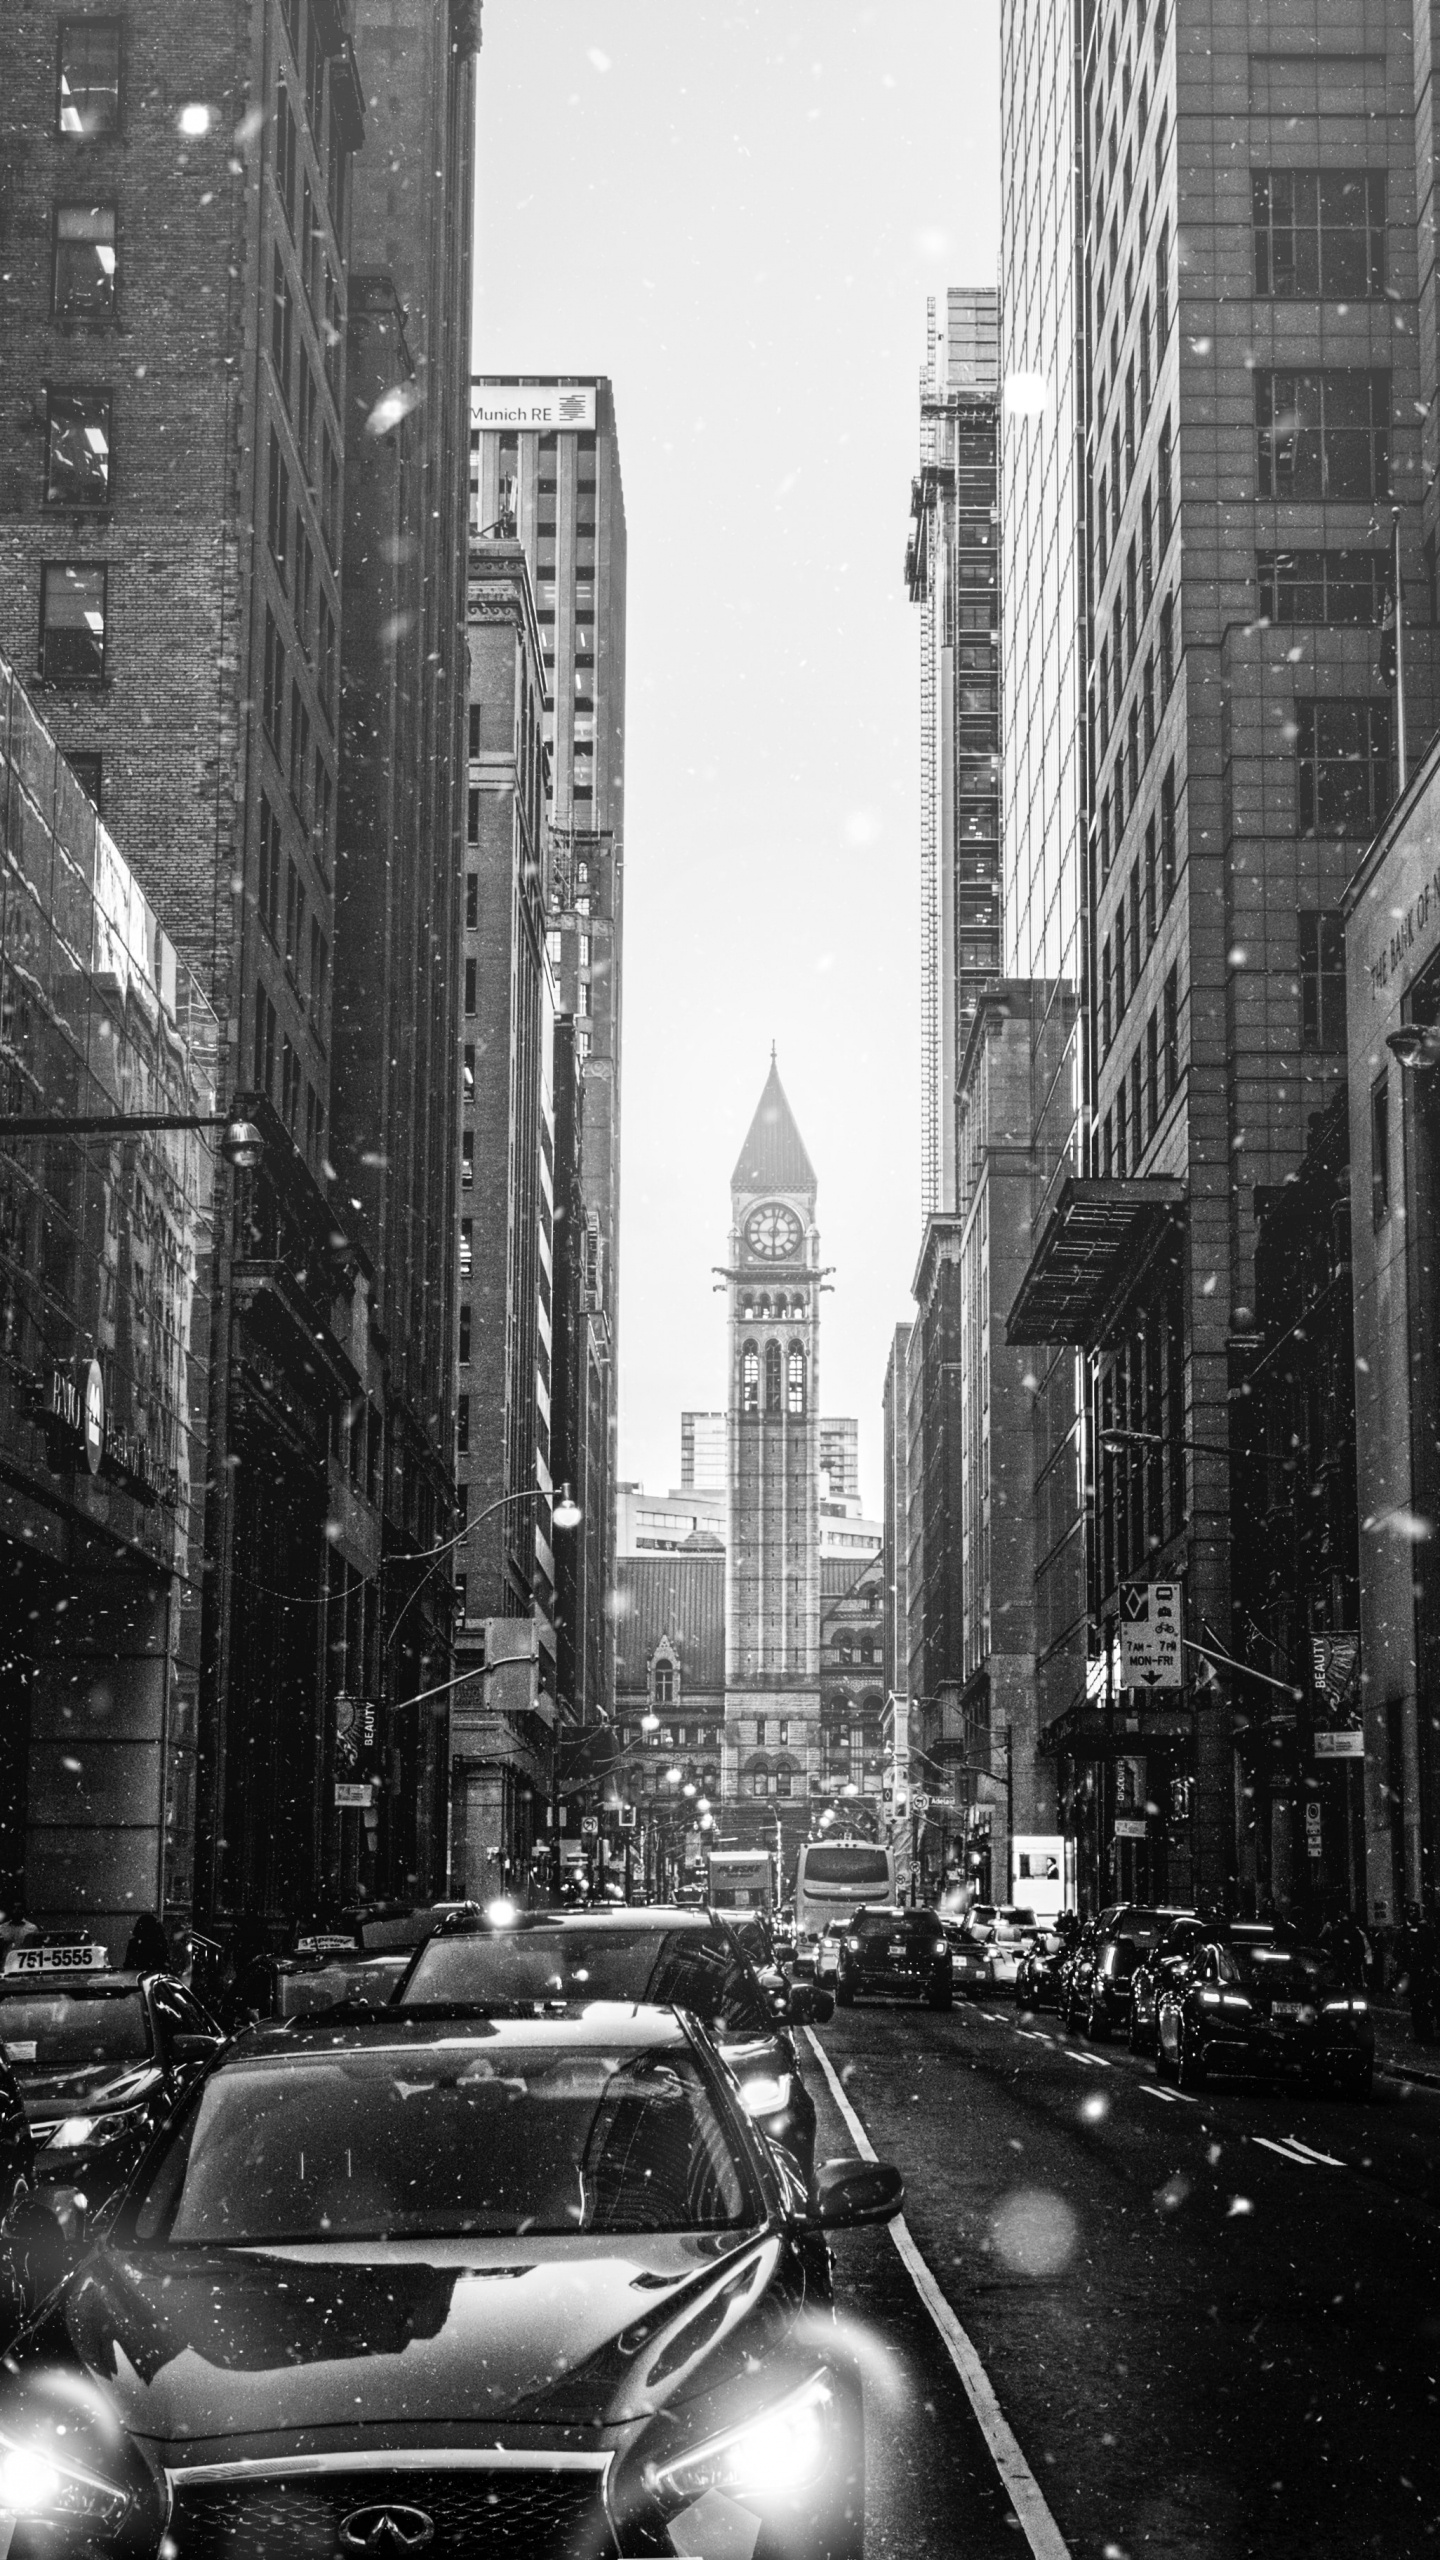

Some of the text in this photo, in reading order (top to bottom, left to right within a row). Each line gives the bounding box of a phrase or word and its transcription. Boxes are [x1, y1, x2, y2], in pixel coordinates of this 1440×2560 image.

[471, 407, 552, 421] Munich RE
[1371, 950, 1387, 1001] THE
[1391, 908, 1414, 972] BANK
[1417, 884, 1429, 931] OF
[1129, 1656, 1174, 1667] MON-FRI
[1312, 1638, 1326, 1688] BEAUTY
[364, 1702, 376, 1746] BEAUTY
[1116, 1760, 1126, 1801] DISCOVER
[17, 1949, 93, 1969] 751-5555
